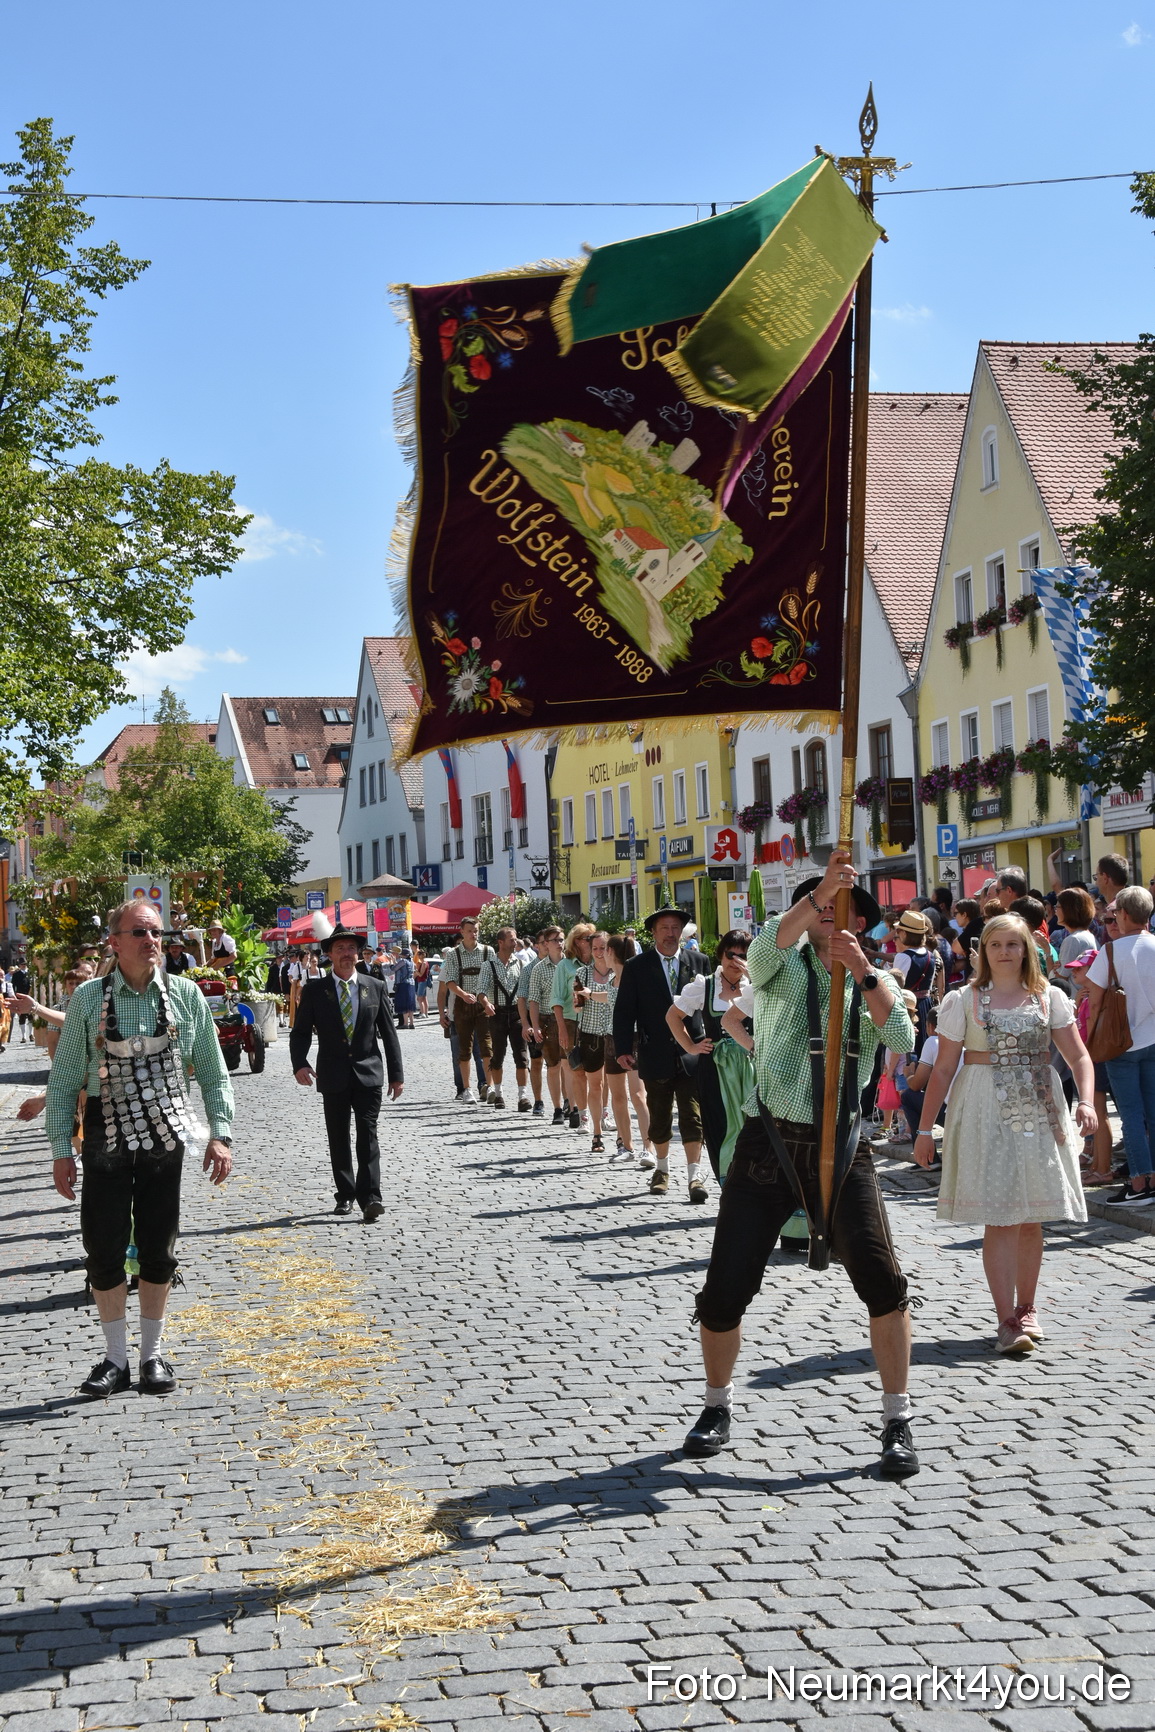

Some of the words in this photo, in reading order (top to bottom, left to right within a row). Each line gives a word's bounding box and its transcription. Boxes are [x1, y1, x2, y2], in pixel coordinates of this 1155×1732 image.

[767, 415, 799, 520] erein
[468, 449, 594, 598] Wolfstein
[588, 763, 610, 785] HOTEL
[615, 759, 639, 777] Lehmeier
[941, 828, 954, 853] P
[591, 863, 620, 878] Restaurant
